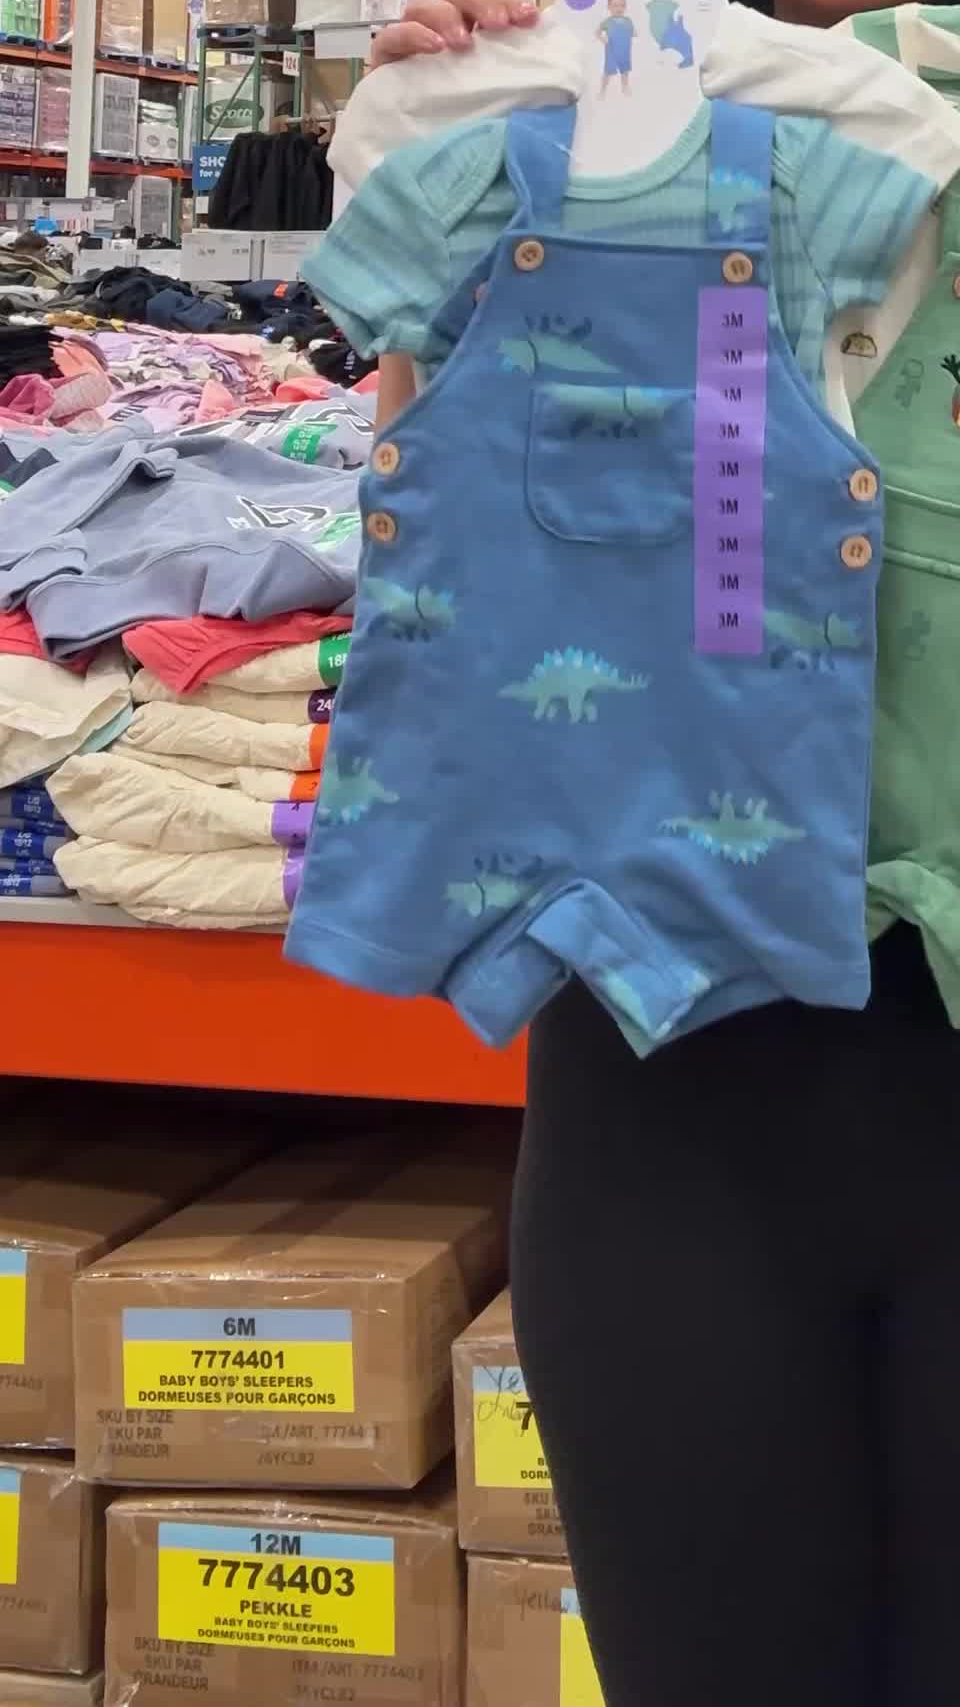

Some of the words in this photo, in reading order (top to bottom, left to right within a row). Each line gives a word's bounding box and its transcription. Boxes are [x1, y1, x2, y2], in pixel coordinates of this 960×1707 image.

[223, 1317, 256, 1336] 6M
[191, 1350, 285, 1369] 7774401
[160, 1375, 195, 1386] BABY
[243, 1376, 313, 1388] SLEEPERS
[138, 1391, 222, 1403] DORMEUSES
[226, 1392, 264, 1404] POUR
[268, 1392, 336, 1407] GARÇONS
[250, 1533, 301, 1556] 12M
[198, 1558, 355, 1597] 7774403
[240, 1599, 312, 1618] PEKKLE
[214, 1617, 243, 1628] BABY
[283, 1622, 338, 1634] SLEEPERS
[197, 1628, 265, 1642] DORMEUSES
[267, 1633, 298, 1644] POUR
[301, 1635, 355, 1649] GARÇONS
